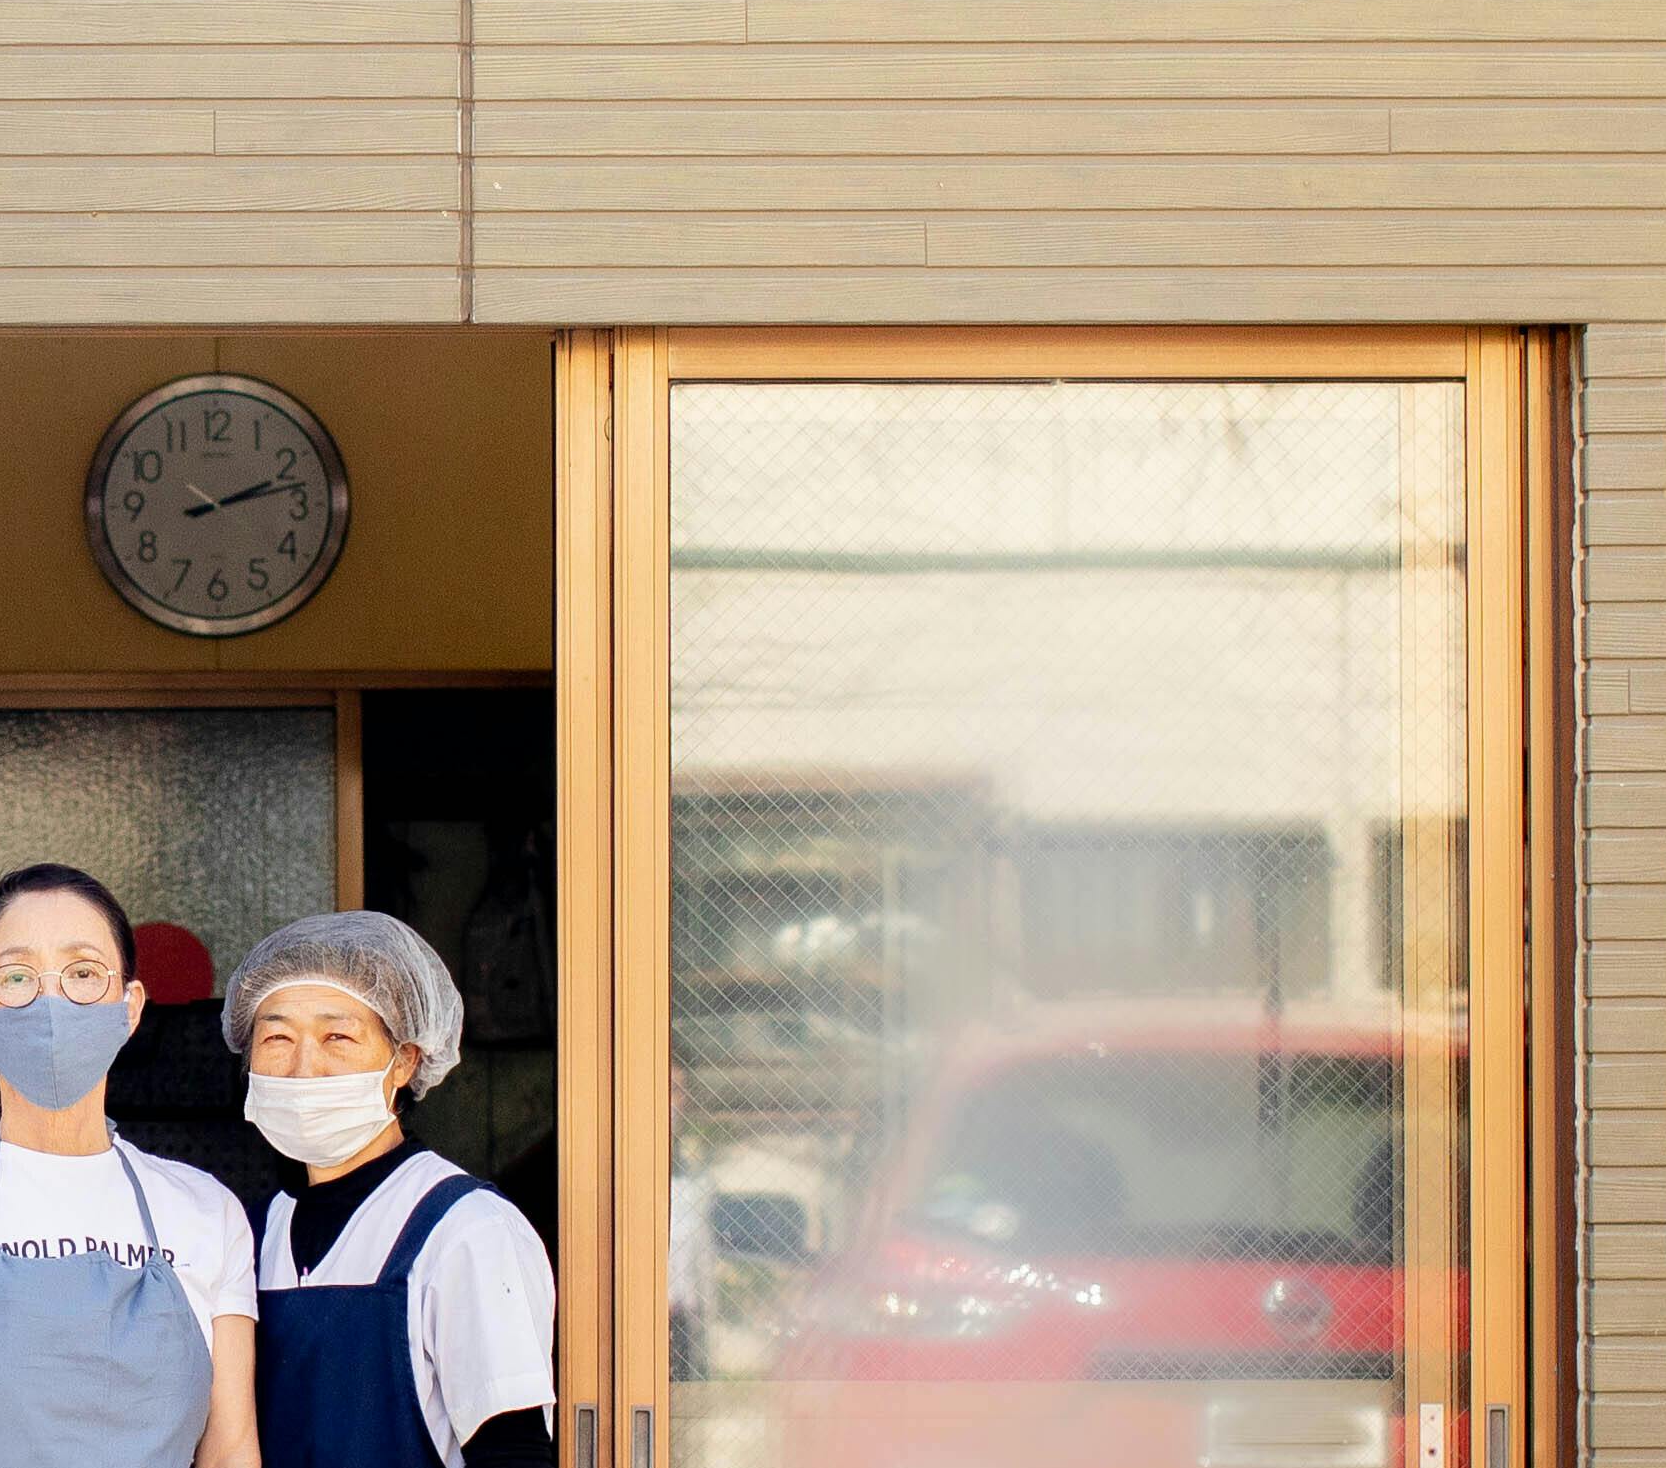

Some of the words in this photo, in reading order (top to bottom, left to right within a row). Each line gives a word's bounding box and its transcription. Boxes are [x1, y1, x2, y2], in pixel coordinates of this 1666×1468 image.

[166, 417, 187, 452] 11
[204, 409, 232, 441] 12
[134, 450, 162, 482] 10
[276, 448, 297, 480] 2
[123, 491, 145, 523] 9
[289, 488, 309, 521] 3
[139, 531, 157, 563] 8
[276, 531, 297, 563] 4
[172, 558, 192, 592] 7
[207, 567, 229, 601] 6
[247, 558, 270, 591] 5
